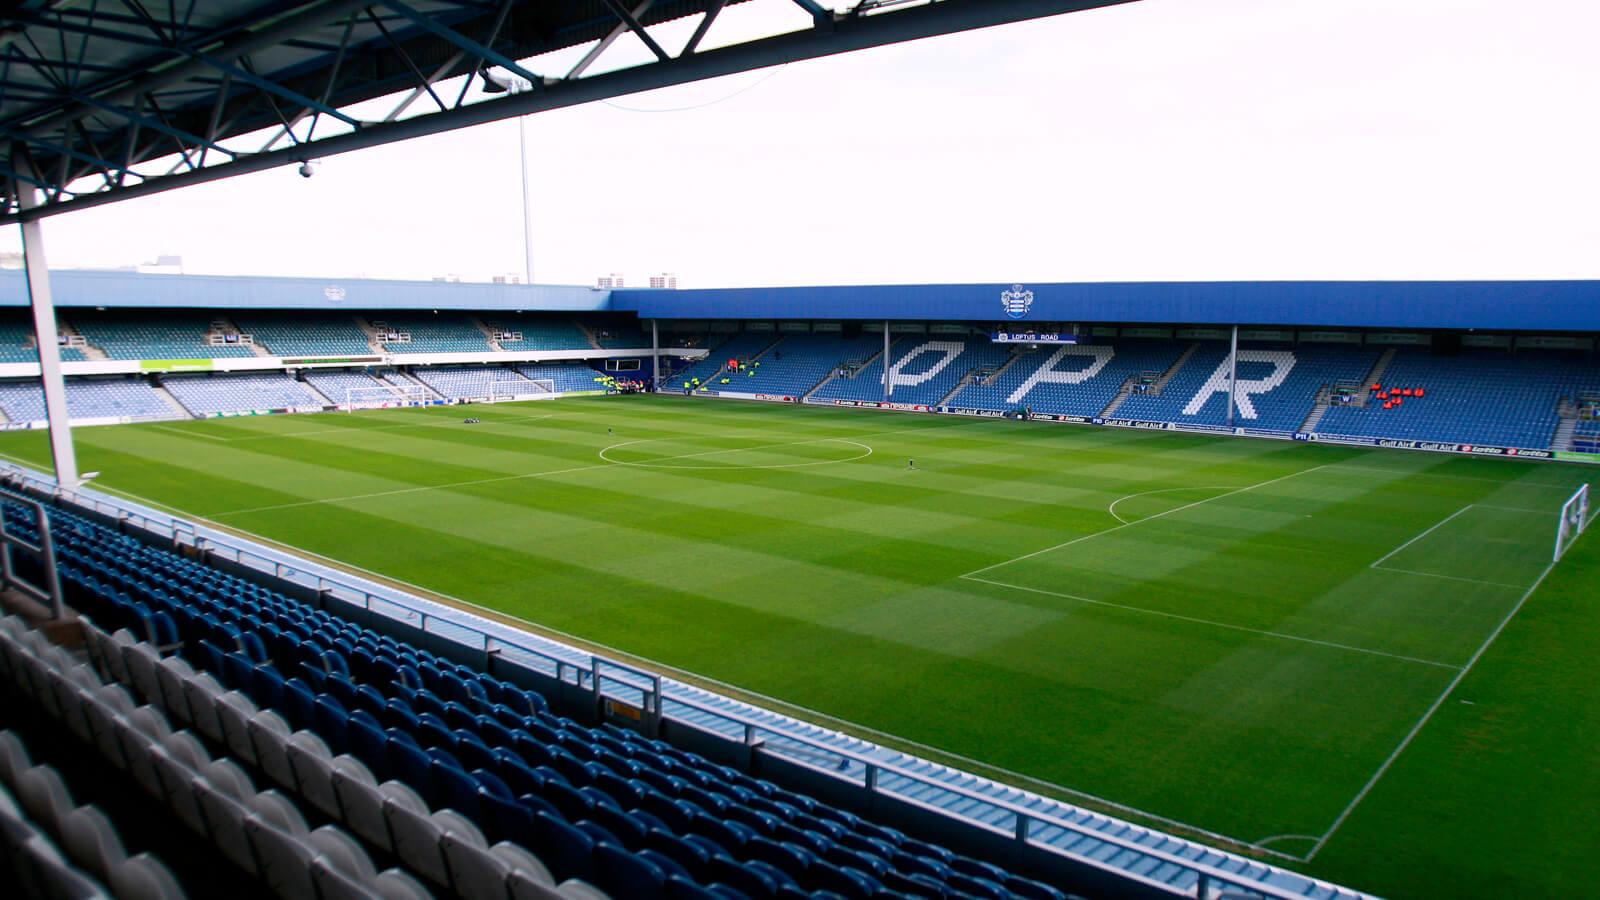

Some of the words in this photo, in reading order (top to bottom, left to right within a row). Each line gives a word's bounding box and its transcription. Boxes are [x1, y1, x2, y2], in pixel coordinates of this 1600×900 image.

[1011, 333, 1036, 341] LOFTUS
[1040, 333, 1059, 341] ROAD
[1379, 439, 1397, 448] Gulf
[1420, 442, 1440, 450] Gulf
